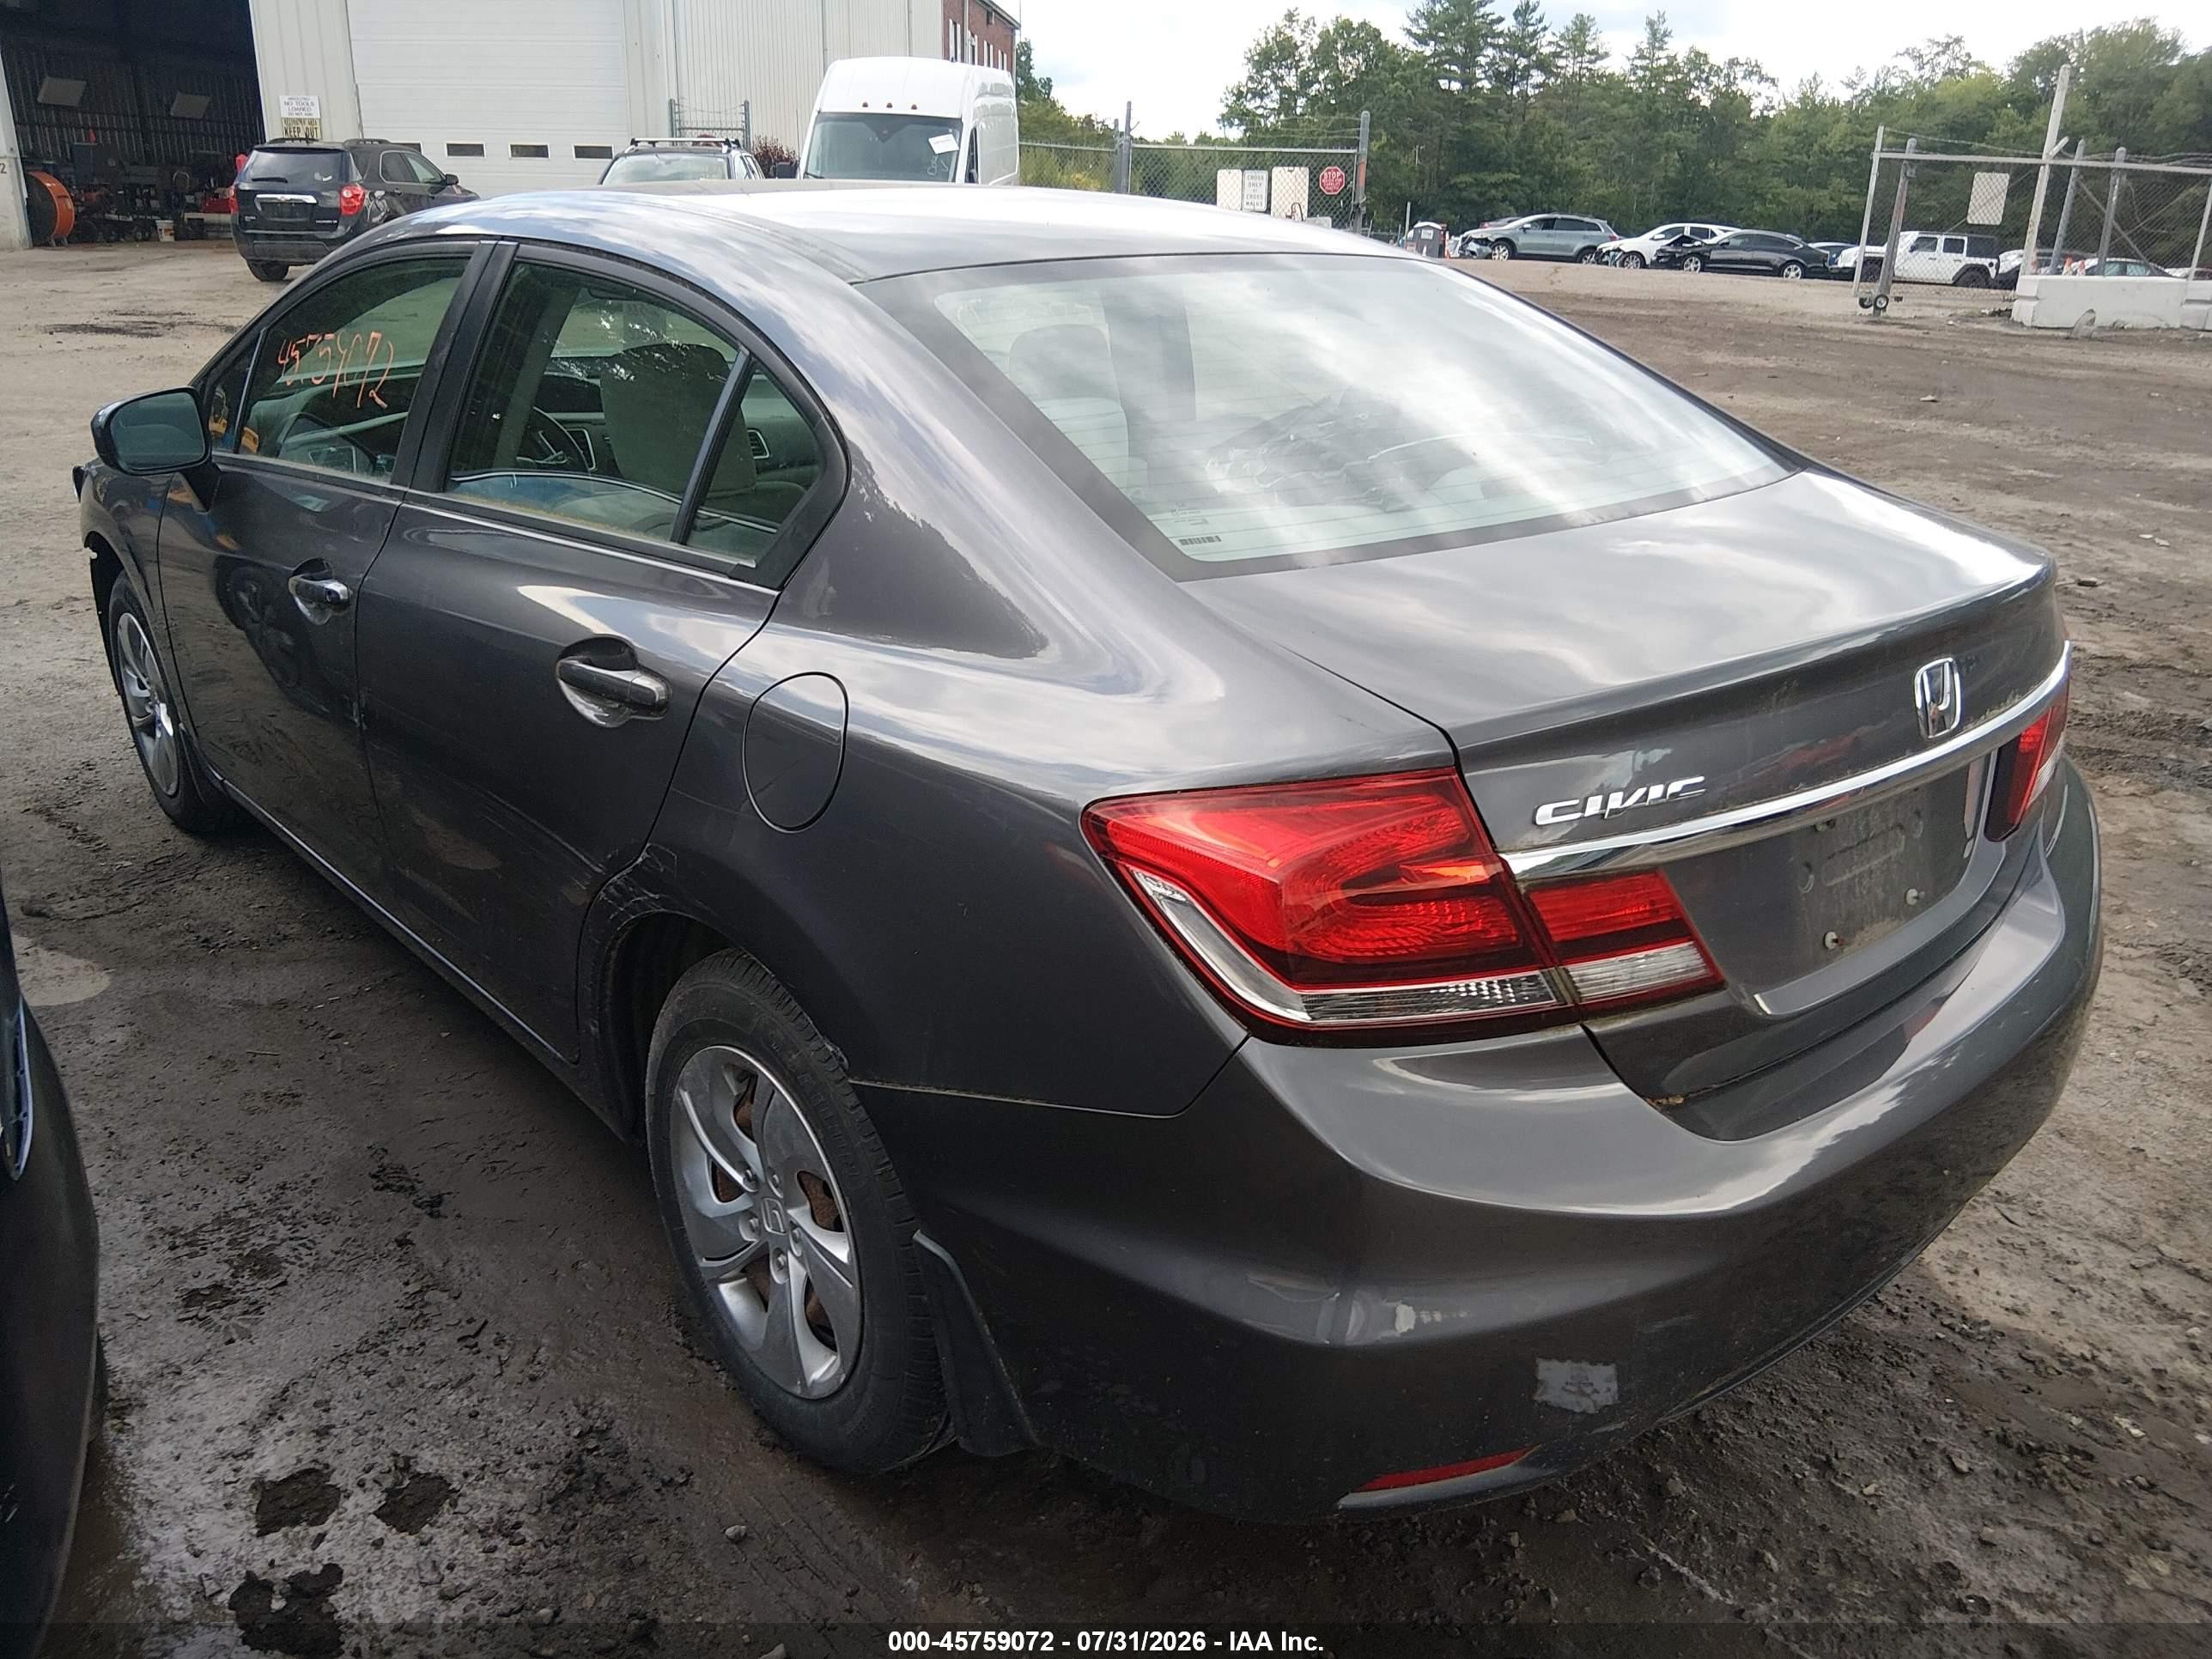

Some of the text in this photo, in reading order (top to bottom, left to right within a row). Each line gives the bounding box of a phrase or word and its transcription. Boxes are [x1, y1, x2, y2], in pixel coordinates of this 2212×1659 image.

[284, 126, 319, 138] KEEP OUT
[1534, 775, 1705, 825] CIVIC
